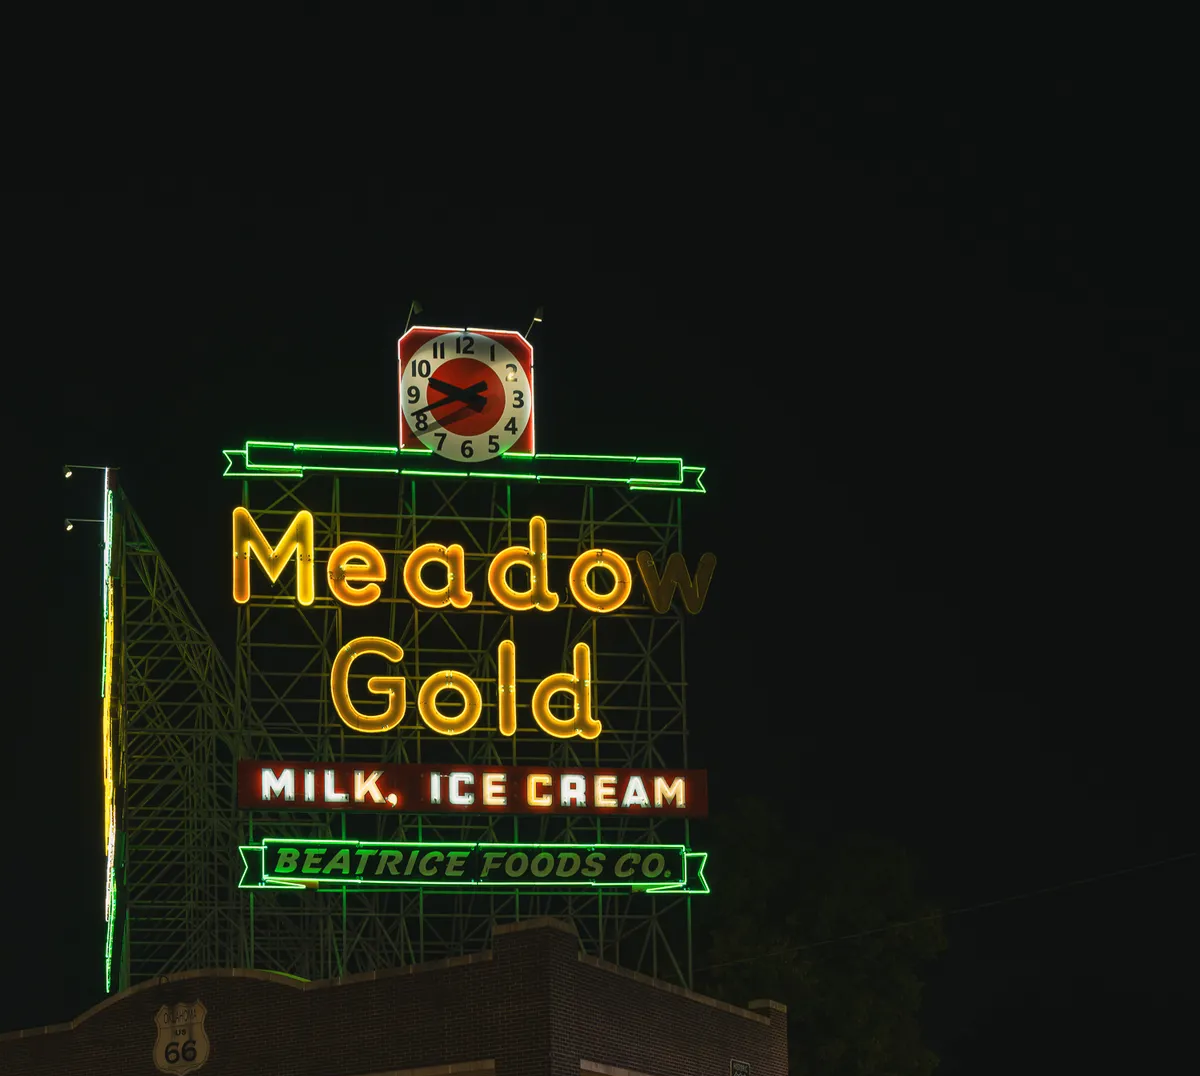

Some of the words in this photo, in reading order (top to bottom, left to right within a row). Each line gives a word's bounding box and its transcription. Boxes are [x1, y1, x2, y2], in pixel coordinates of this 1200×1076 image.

[433, 342, 445, 359] 11
[456, 337, 474, 354] 12
[490, 344, 495, 361] 1
[411, 360, 431, 377] 10
[505, 364, 517, 382] 2
[407, 386, 420, 404] 9
[512, 390, 524, 408] 3
[415, 413, 428, 431] 8
[504, 417, 518, 435] 4
[434, 433, 447, 450] 7
[461, 440, 474, 458] 6
[488, 435, 500, 453] 5
[232, 506, 717, 615] Meadow
[330, 636, 602, 740] Gold
[261, 767, 398, 808] MILK,
[430, 771, 507, 806] ICE
[527, 773, 687, 809] CREAM
[274, 847, 471, 878] BEATRICE
[480, 851, 607, 879] FOODS
[614, 853, 672, 879] CO.
[175, 1028, 187, 1036] US
[165, 1040, 197, 1064] 66
